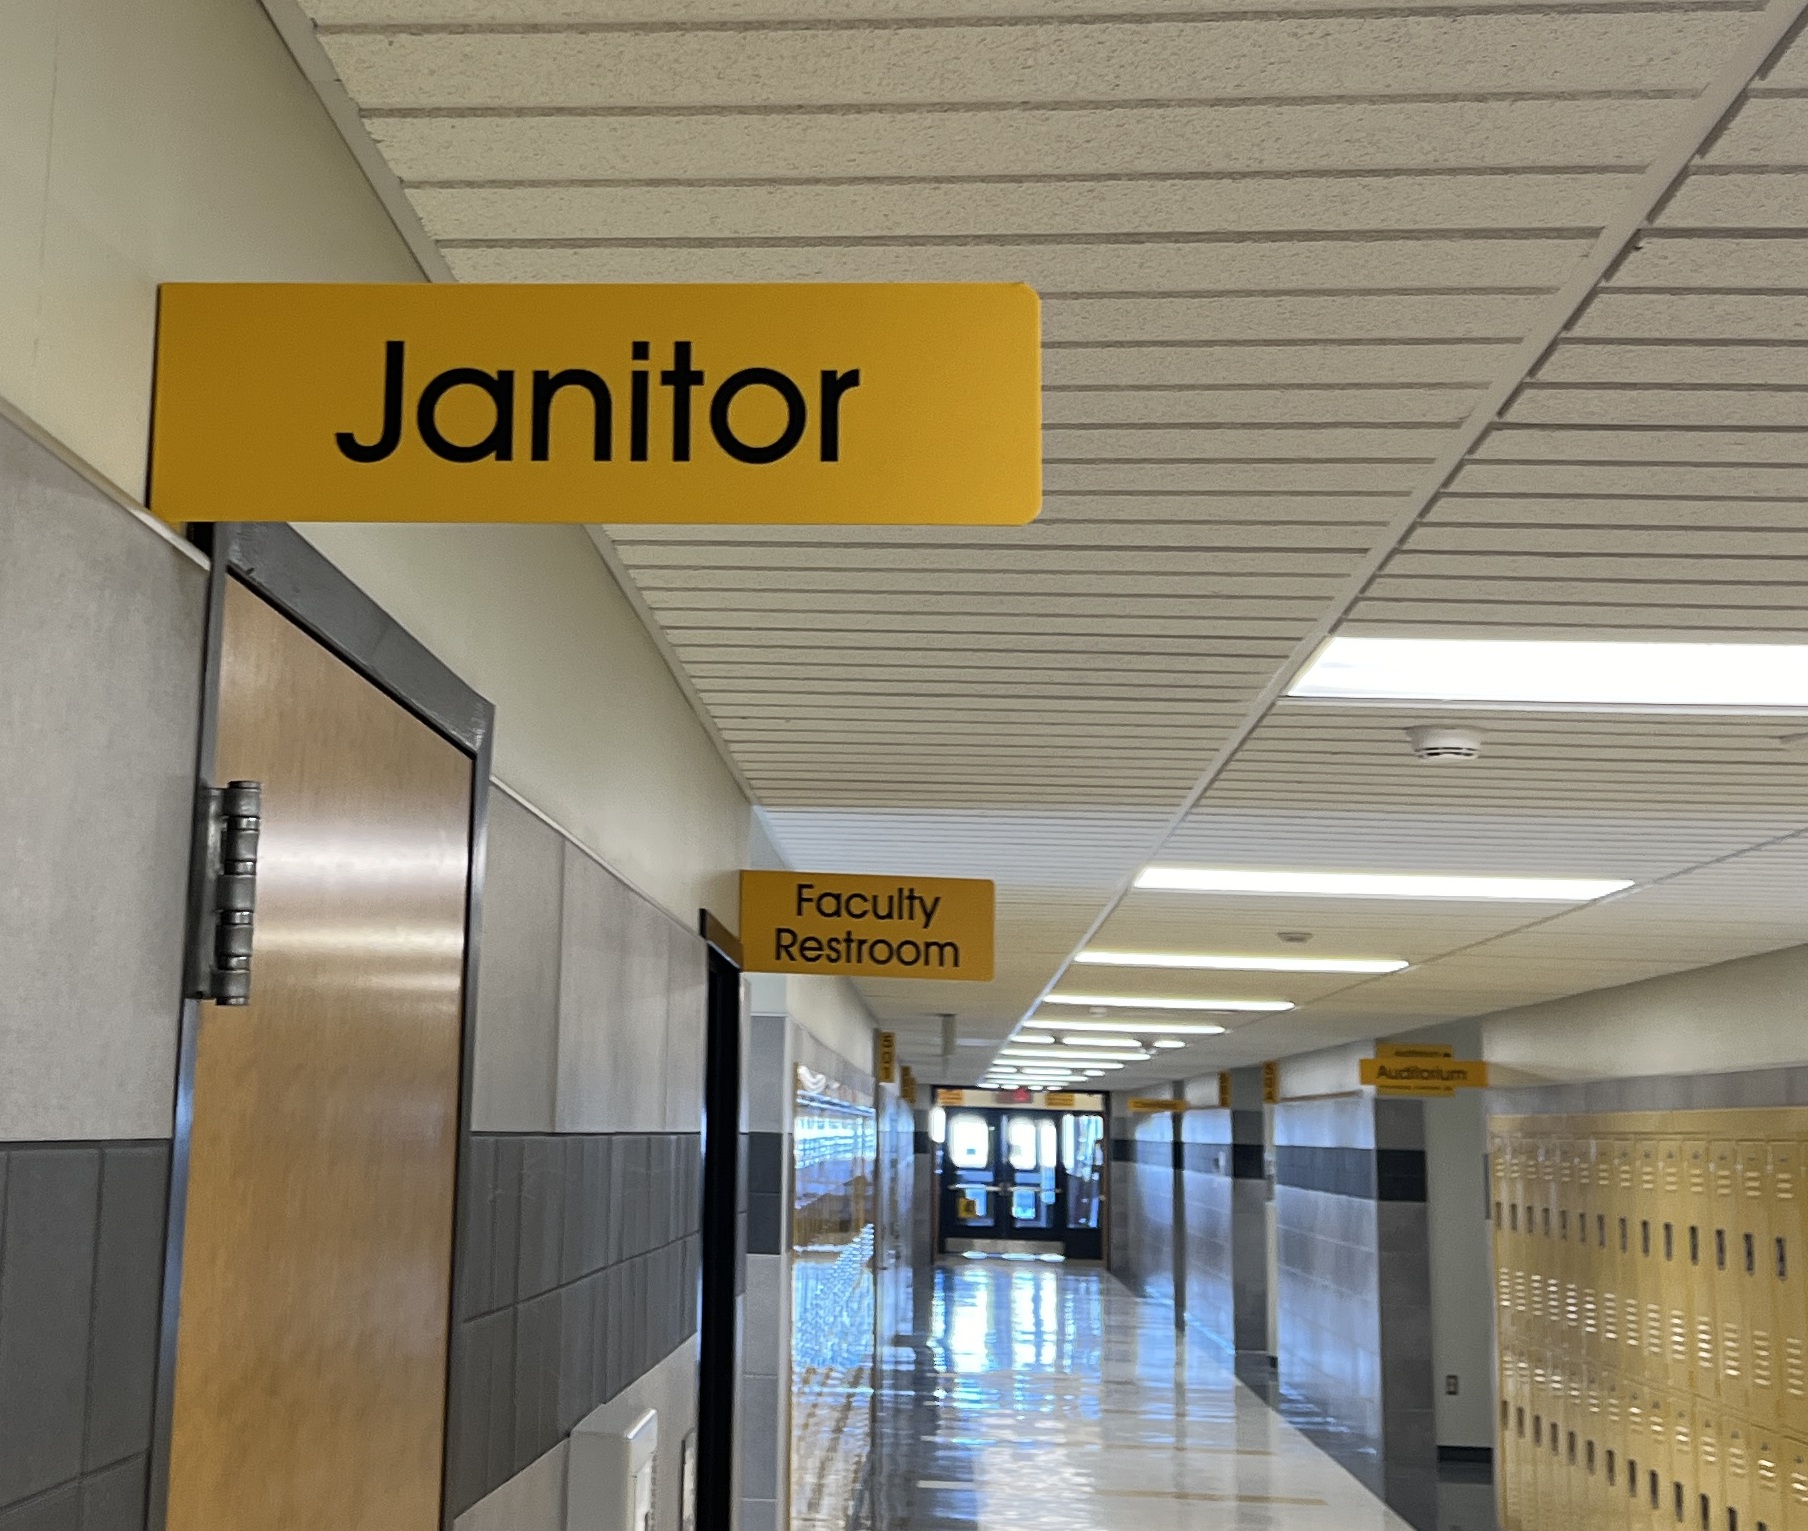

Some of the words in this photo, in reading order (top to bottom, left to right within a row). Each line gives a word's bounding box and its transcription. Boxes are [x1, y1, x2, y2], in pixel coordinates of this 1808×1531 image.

[335, 340, 860, 465] Janitor
[796, 883, 941, 929] Faculty
[774, 927, 960, 968] Restroom
[1376, 1064, 1469, 1081] Auditorium
